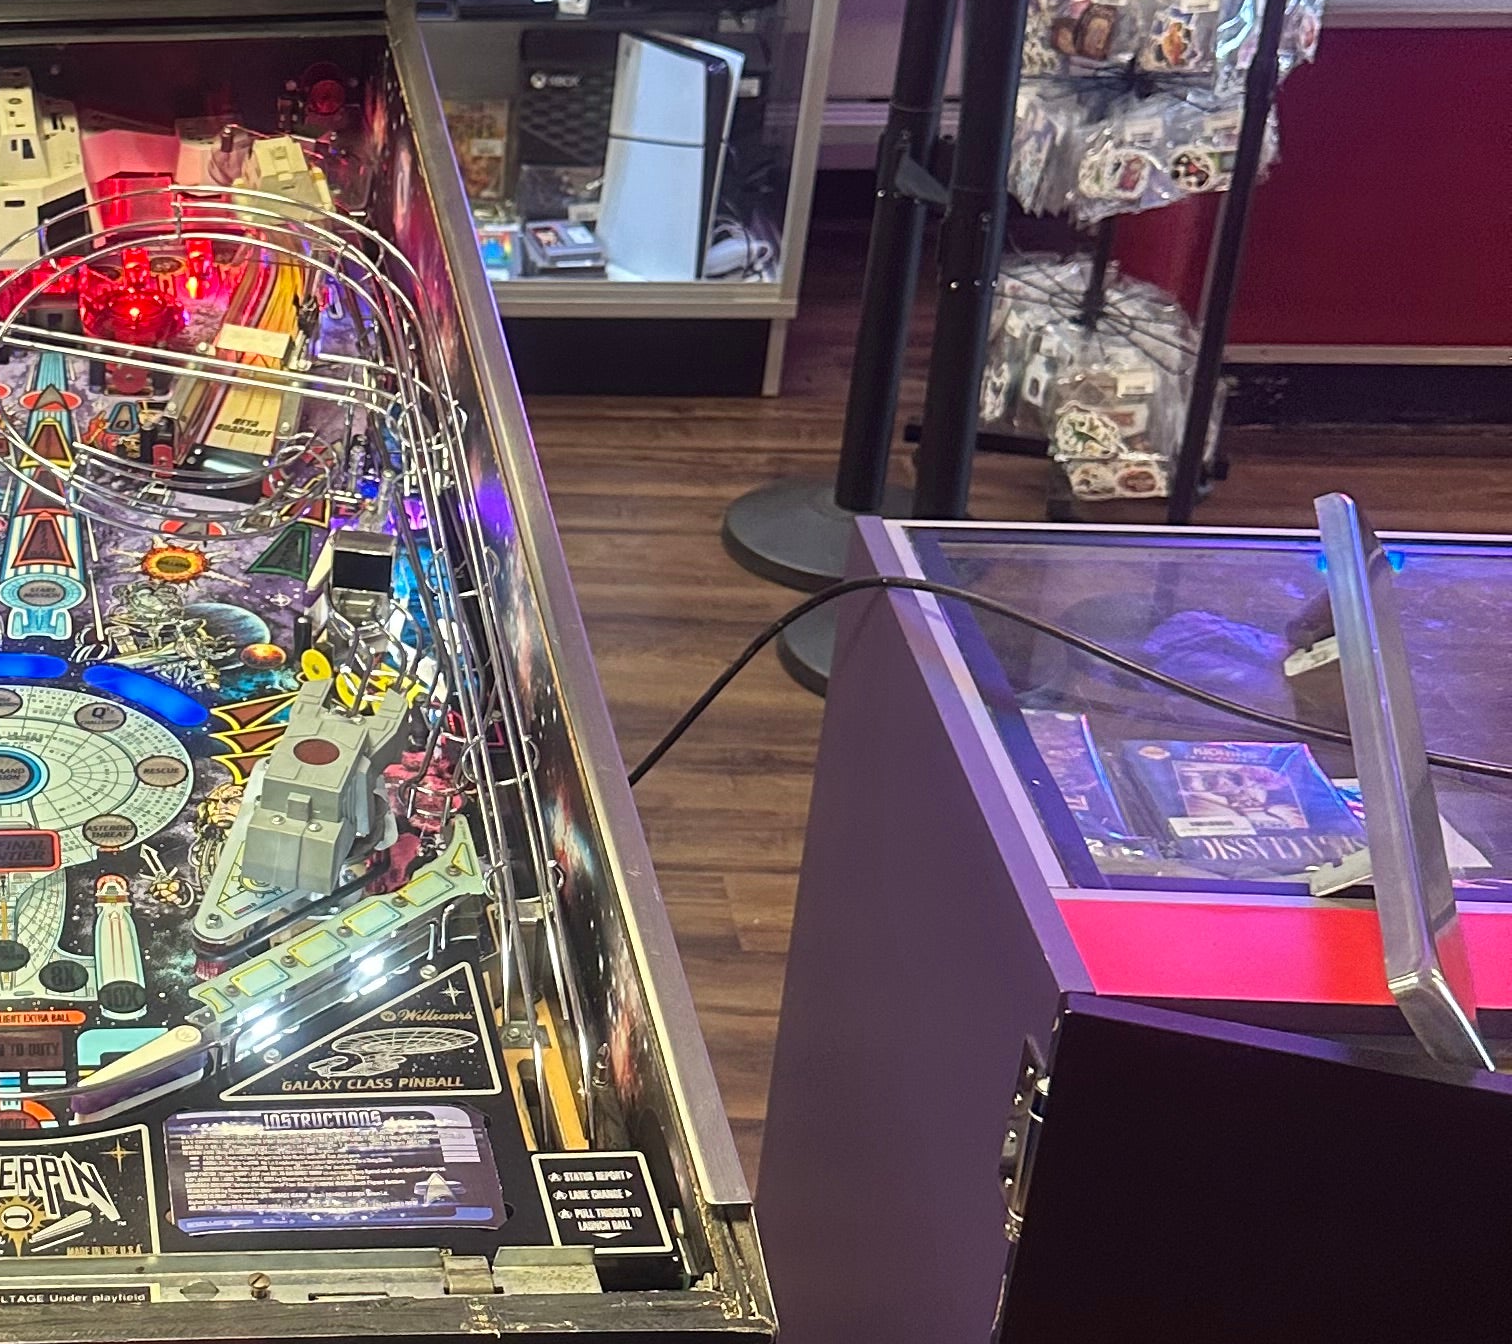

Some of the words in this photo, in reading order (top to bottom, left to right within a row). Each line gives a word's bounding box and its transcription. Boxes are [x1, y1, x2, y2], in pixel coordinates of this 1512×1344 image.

[87, 824, 134, 832] ASTEROID
[51, 967, 77, 981] 8X
[51, 1014, 70, 1022] BALL
[398, 1009, 473, 1021] Williams
[10, 1044, 24, 1057] TO
[281, 1079, 343, 1091] GALAXY
[346, 1077, 393, 1089] CLASS
[398, 1076, 464, 1088] PINBALL
[262, 1110, 383, 1130] INSTRUCTIONS
[563, 1171, 595, 1182] STATUS
[595, 1170, 625, 1181] REPORT
[568, 1190, 590, 1200] LANE
[591, 1189, 625, 1199] CHANGE
[574, 1208, 595, 1219] PULL
[631, 1207, 643, 1218] TO
[578, 1221, 611, 1231] LAUNCH
[611, 1220, 633, 1230] BALL
[50, 1293, 88, 1303] Under
[92, 1292, 146, 1304] playfield
